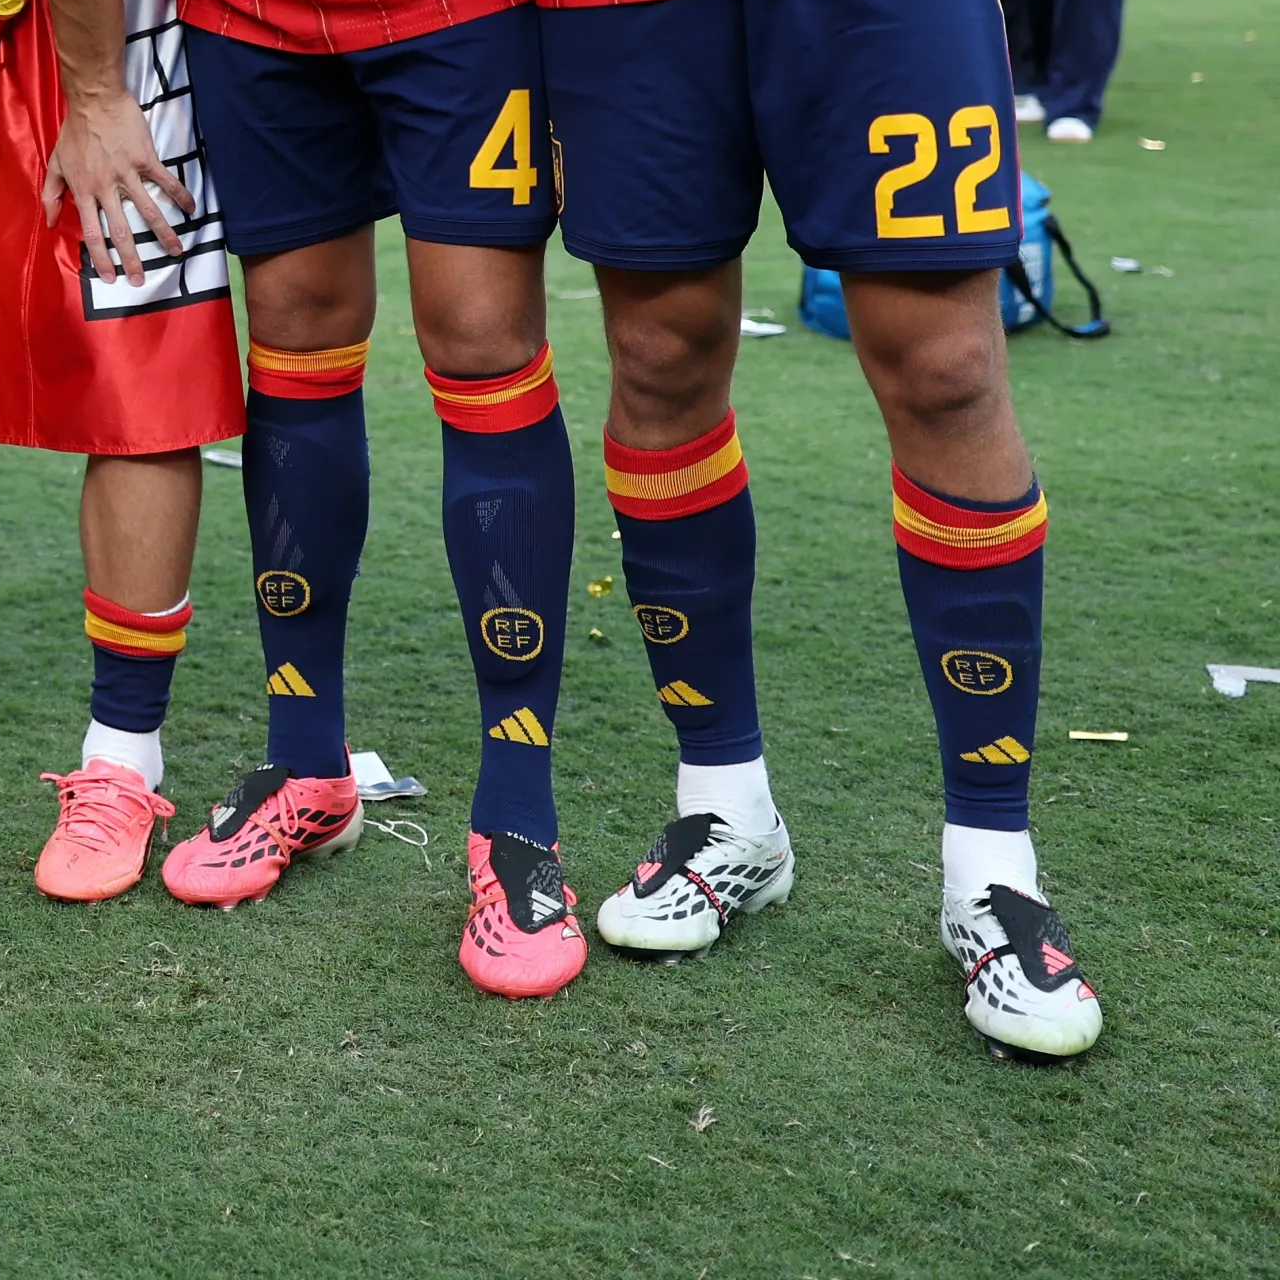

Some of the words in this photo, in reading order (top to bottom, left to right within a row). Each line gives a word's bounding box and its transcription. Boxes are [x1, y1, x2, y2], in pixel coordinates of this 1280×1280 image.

[468, 89, 538, 206] 4
[868, 104, 1010, 239] 22
[266, 581, 295, 594] RF
[268, 595, 295, 608] EF
[641, 612, 670, 624] RF
[495, 618, 529, 633] RF
[644, 624, 673, 636] EF
[497, 634, 531, 649] EF
[955, 659, 993, 672] RF
[958, 672, 996, 685] EF
